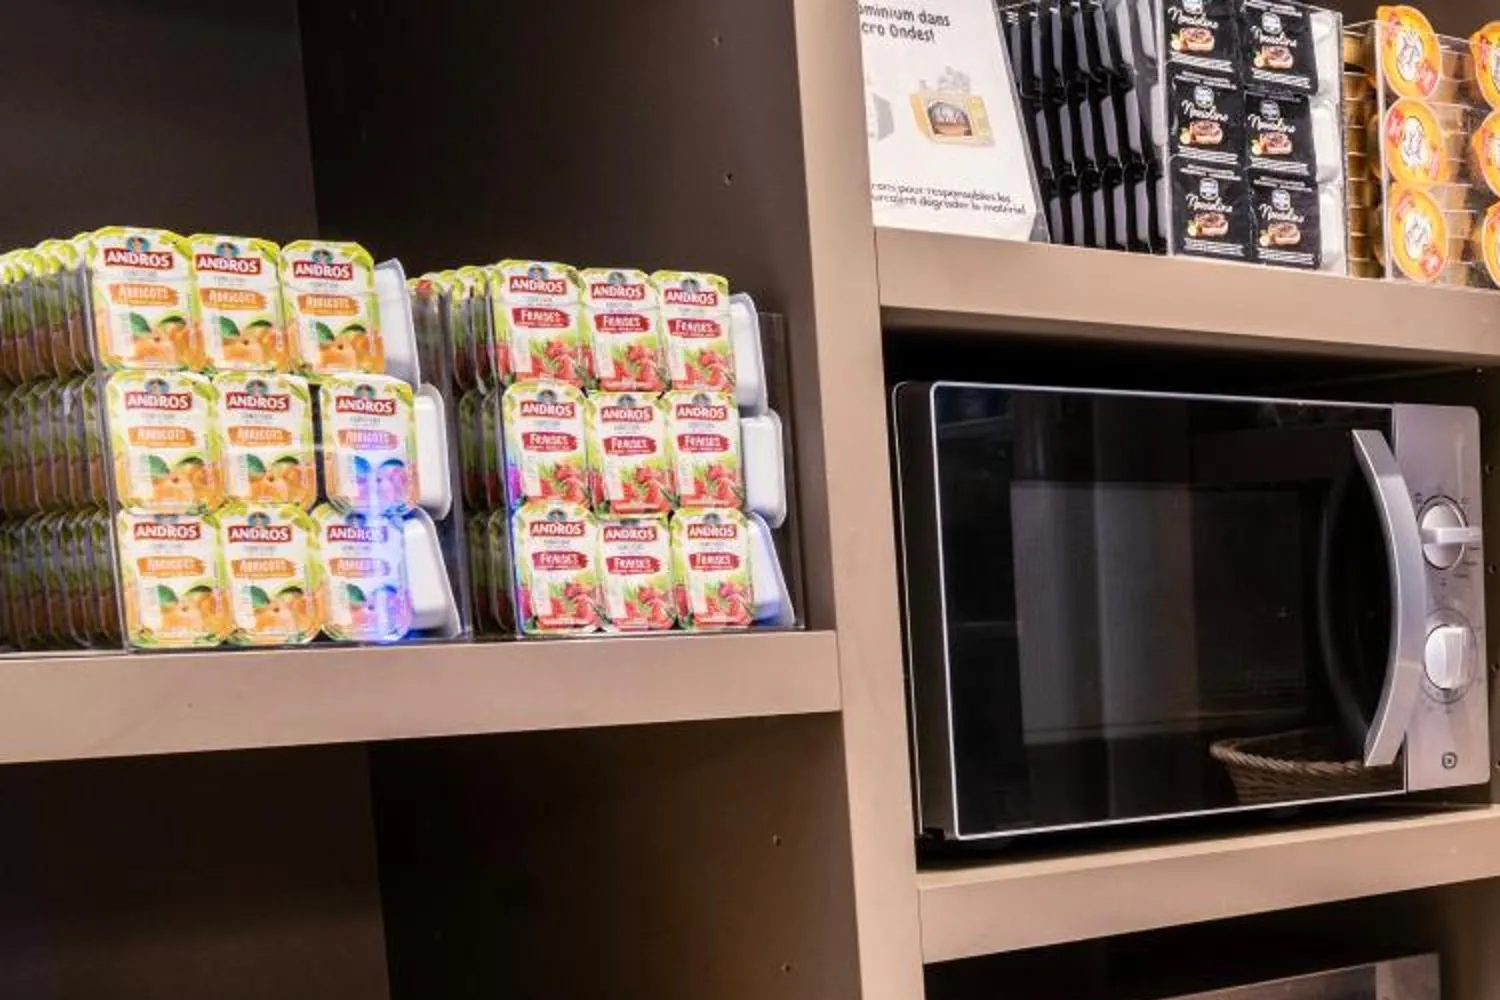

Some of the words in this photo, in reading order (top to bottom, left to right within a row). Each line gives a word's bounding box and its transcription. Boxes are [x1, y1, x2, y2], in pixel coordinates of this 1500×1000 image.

[918, 9, 950, 26] dans
[107, 251, 170, 267] ANDROS
[198, 256, 259, 273] ANDROS
[296, 262, 350, 279] ANDROS
[511, 279, 563, 293] ANDROS
[593, 285, 643, 298] ANDROS
[667, 291, 715, 305] ANDROS
[128, 394, 189, 409] ANDROS
[229, 394, 287, 410] ANDROS
[337, 398, 393, 414] ANDROS
[523, 403, 572, 417] ANDROS
[603, 408, 650, 421] ANDROS
[677, 405, 725, 419] ANDROS
[136, 525, 197, 538] ANDROS
[231, 528, 289, 541] ANDROS
[532, 522, 581, 536] ANDROS
[606, 528, 655, 541] ANDROS
[690, 525, 734, 538] ANDROS
